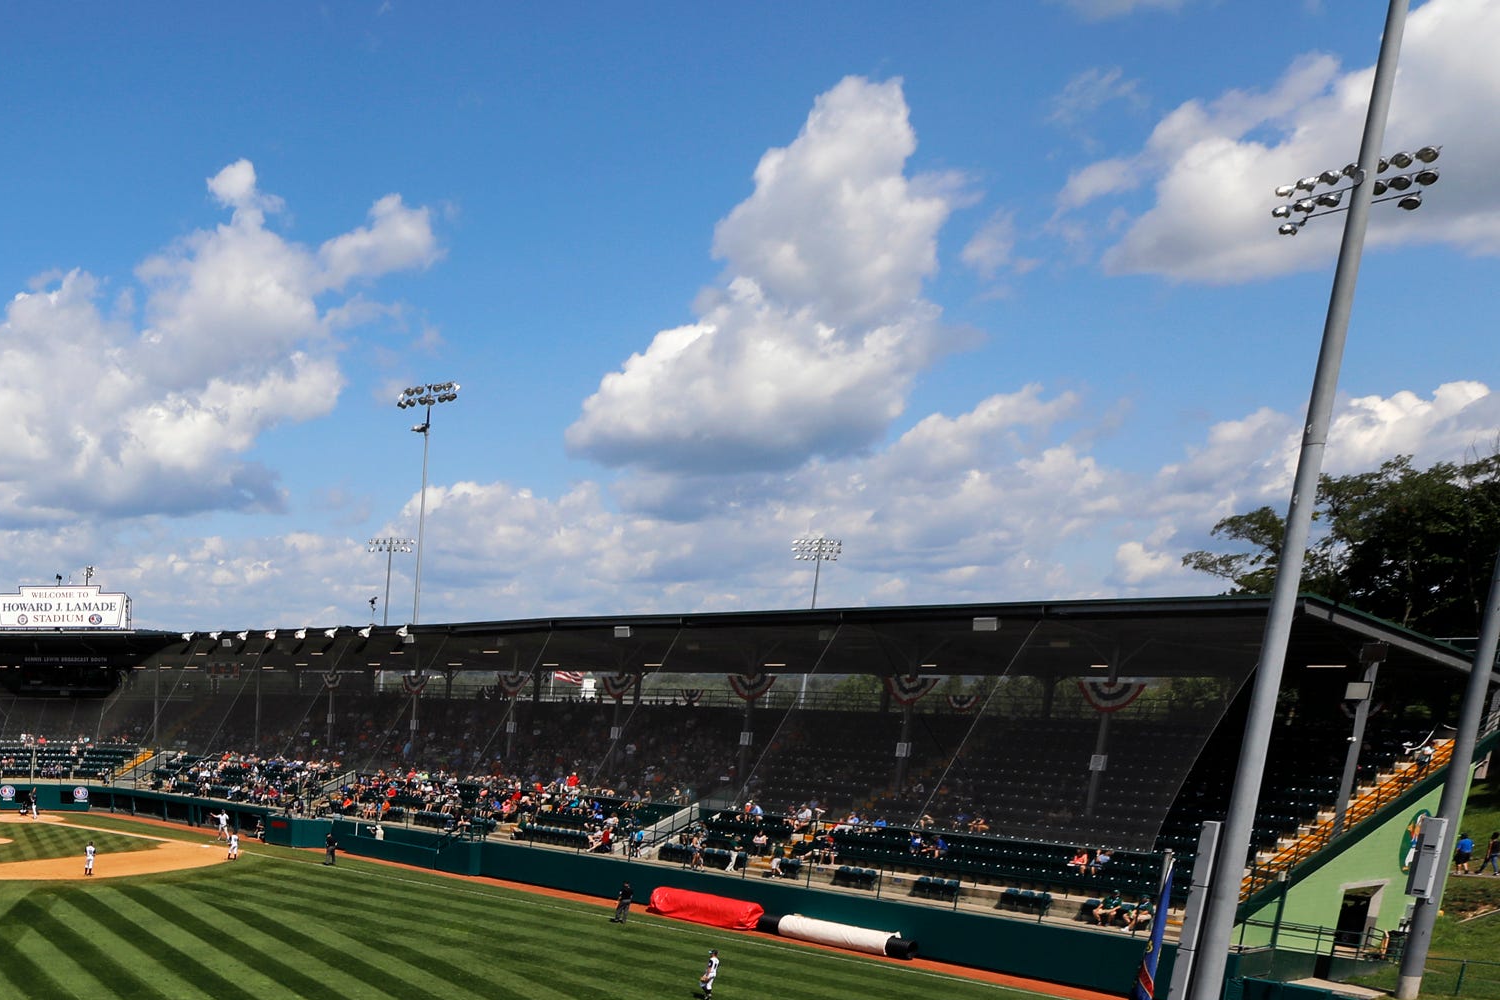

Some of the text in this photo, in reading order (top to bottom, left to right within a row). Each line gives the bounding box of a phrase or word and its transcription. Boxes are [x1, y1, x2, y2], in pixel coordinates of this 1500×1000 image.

[31, 591, 75, 599] WELCOME
[2, 602, 117, 612] HOWARD J. LAMADE
[33, 614, 84, 623] STADIUM
